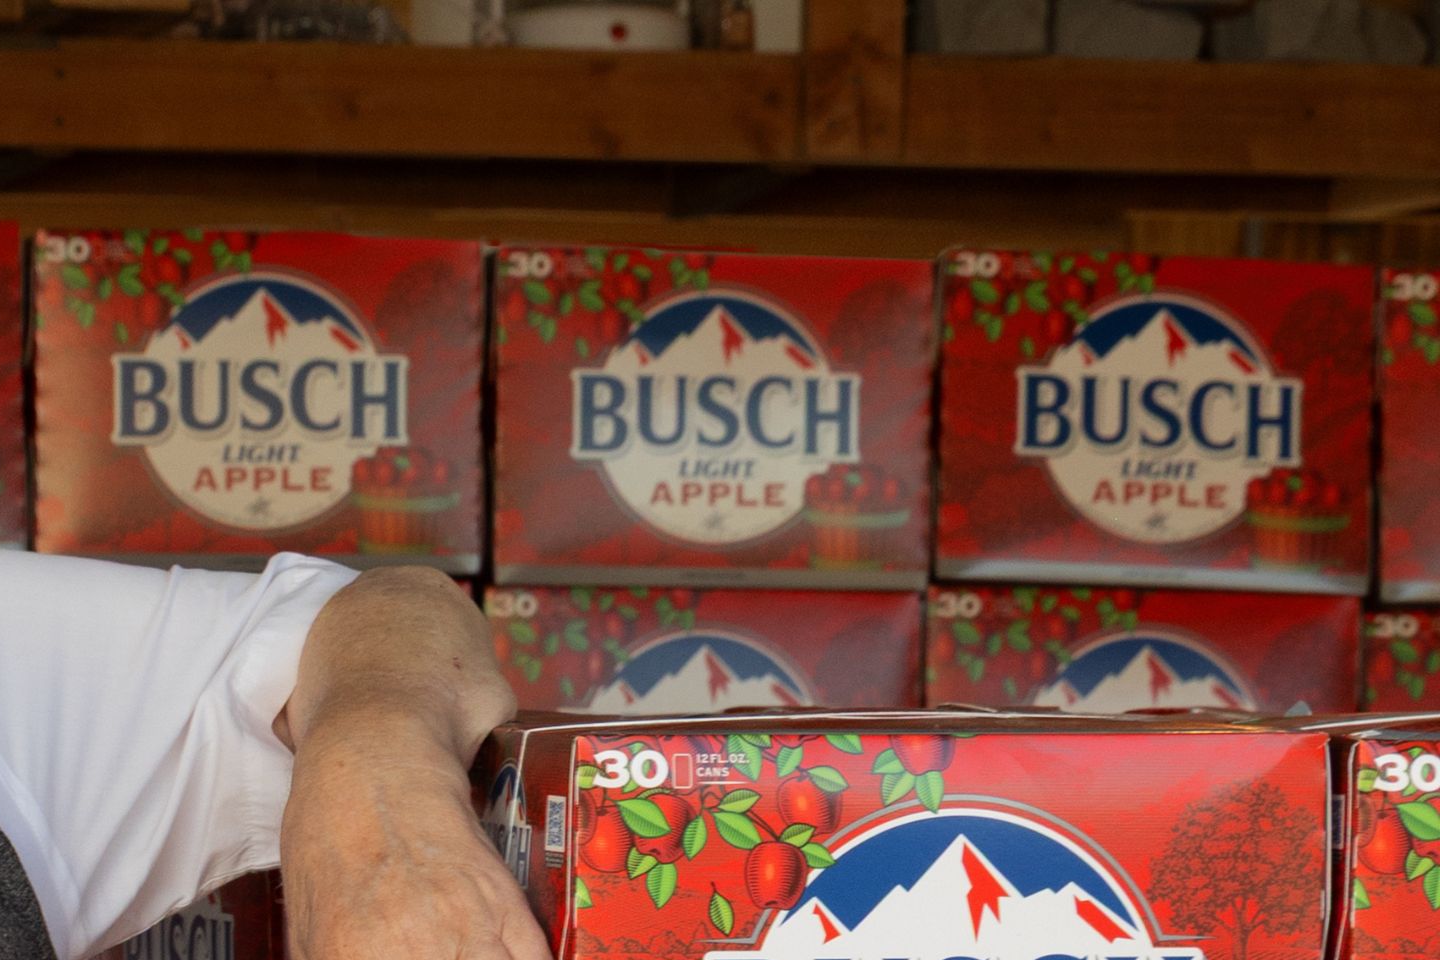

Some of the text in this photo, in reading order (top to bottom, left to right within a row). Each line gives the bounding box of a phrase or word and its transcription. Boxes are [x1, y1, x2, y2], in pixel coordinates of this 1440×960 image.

[46, 237, 91, 262] 30
[509, 252, 552, 278] 30
[956, 252, 1001, 277] 30
[1393, 274, 1437, 300] 30
[119, 358, 404, 440] BUSCH
[578, 374, 854, 459] BUSCH
[1022, 375, 1296, 461] BUSCH
[221, 444, 302, 464] LIGHT
[194, 466, 333, 493] APPLE
[678, 458, 756, 480] LIGHT
[1120, 458, 1198, 481] LIGHT
[650, 480, 787, 508] APPLE
[1092, 480, 1228, 508] APPLE
[497, 594, 538, 618] 30
[938, 594, 981, 618] 30
[1374, 615, 1419, 638] 30
[593, 749, 669, 789] 30
[695, 766, 731, 777] CANS
[1373, 753, 1440, 793] 30
